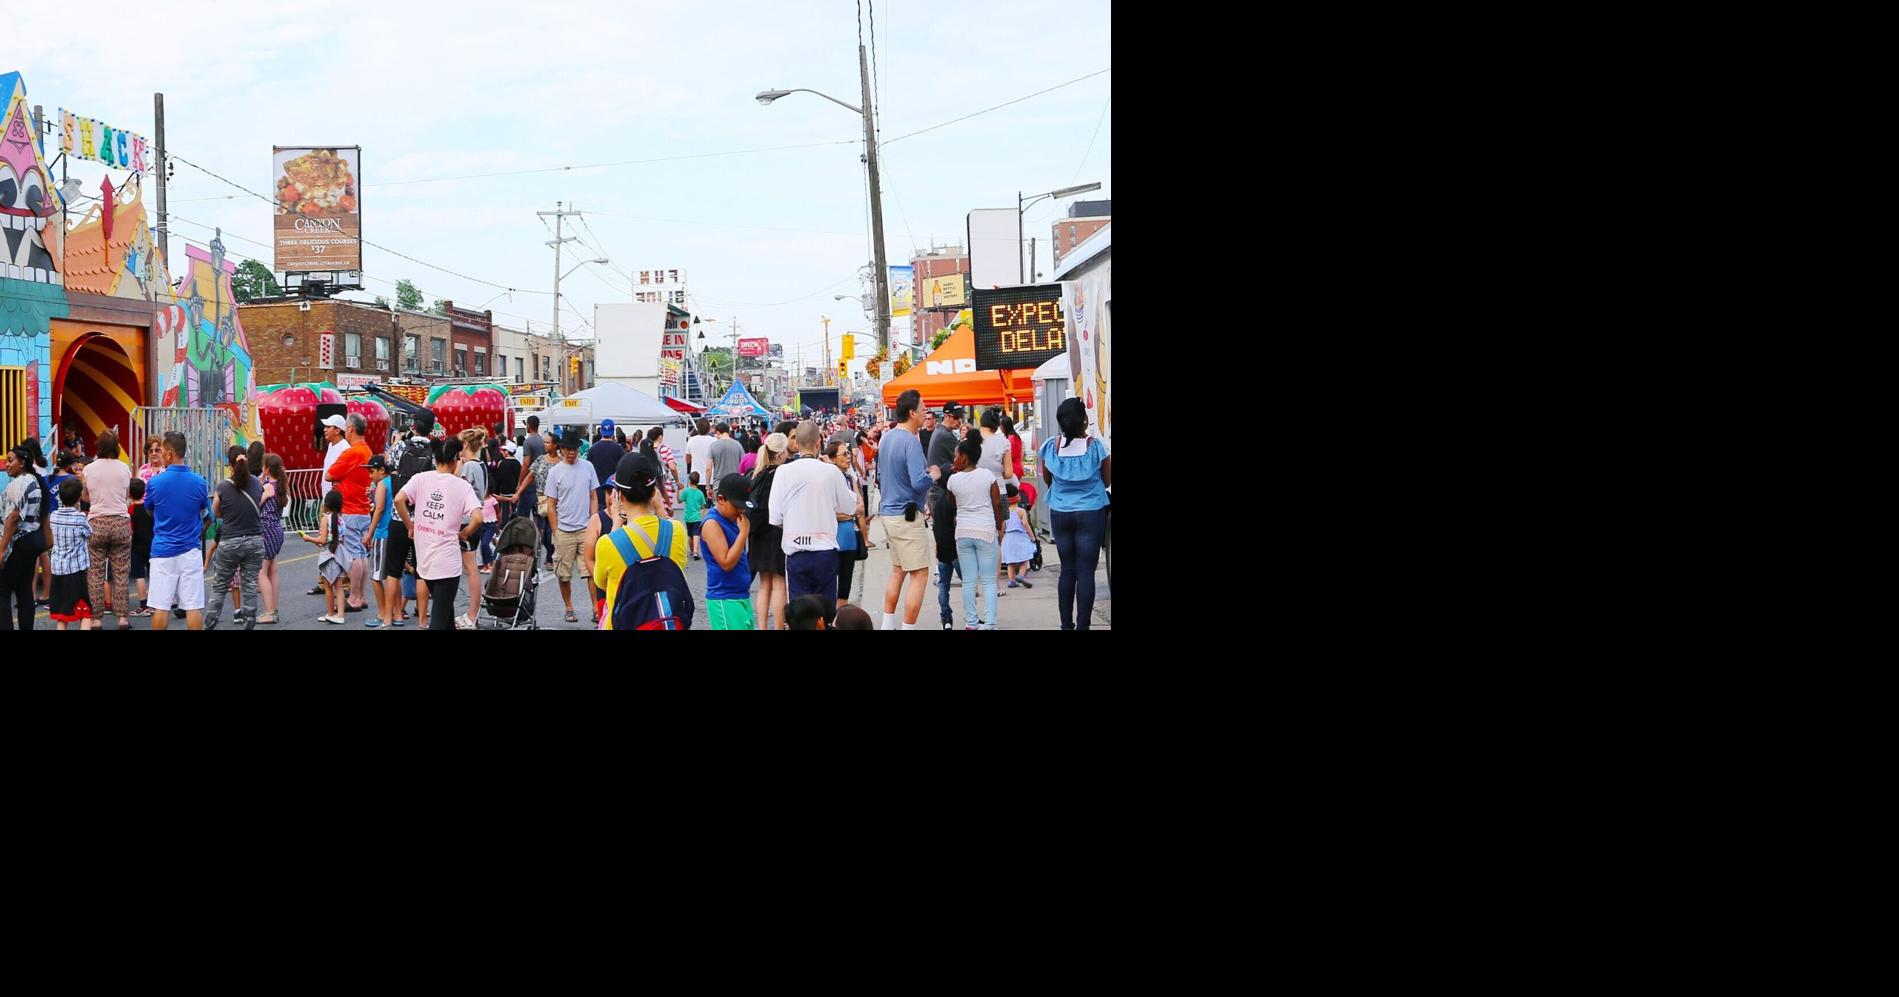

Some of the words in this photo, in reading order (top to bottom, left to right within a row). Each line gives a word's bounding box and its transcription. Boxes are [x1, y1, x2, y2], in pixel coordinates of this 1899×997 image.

[63, 111, 145, 172] SHACK
[294, 218, 340, 230] CANYON
[674, 334, 685, 345] IN
[1001, 328, 1065, 352] DELA
[926, 358, 977, 376] ND
[422, 509, 444, 520] CALM
